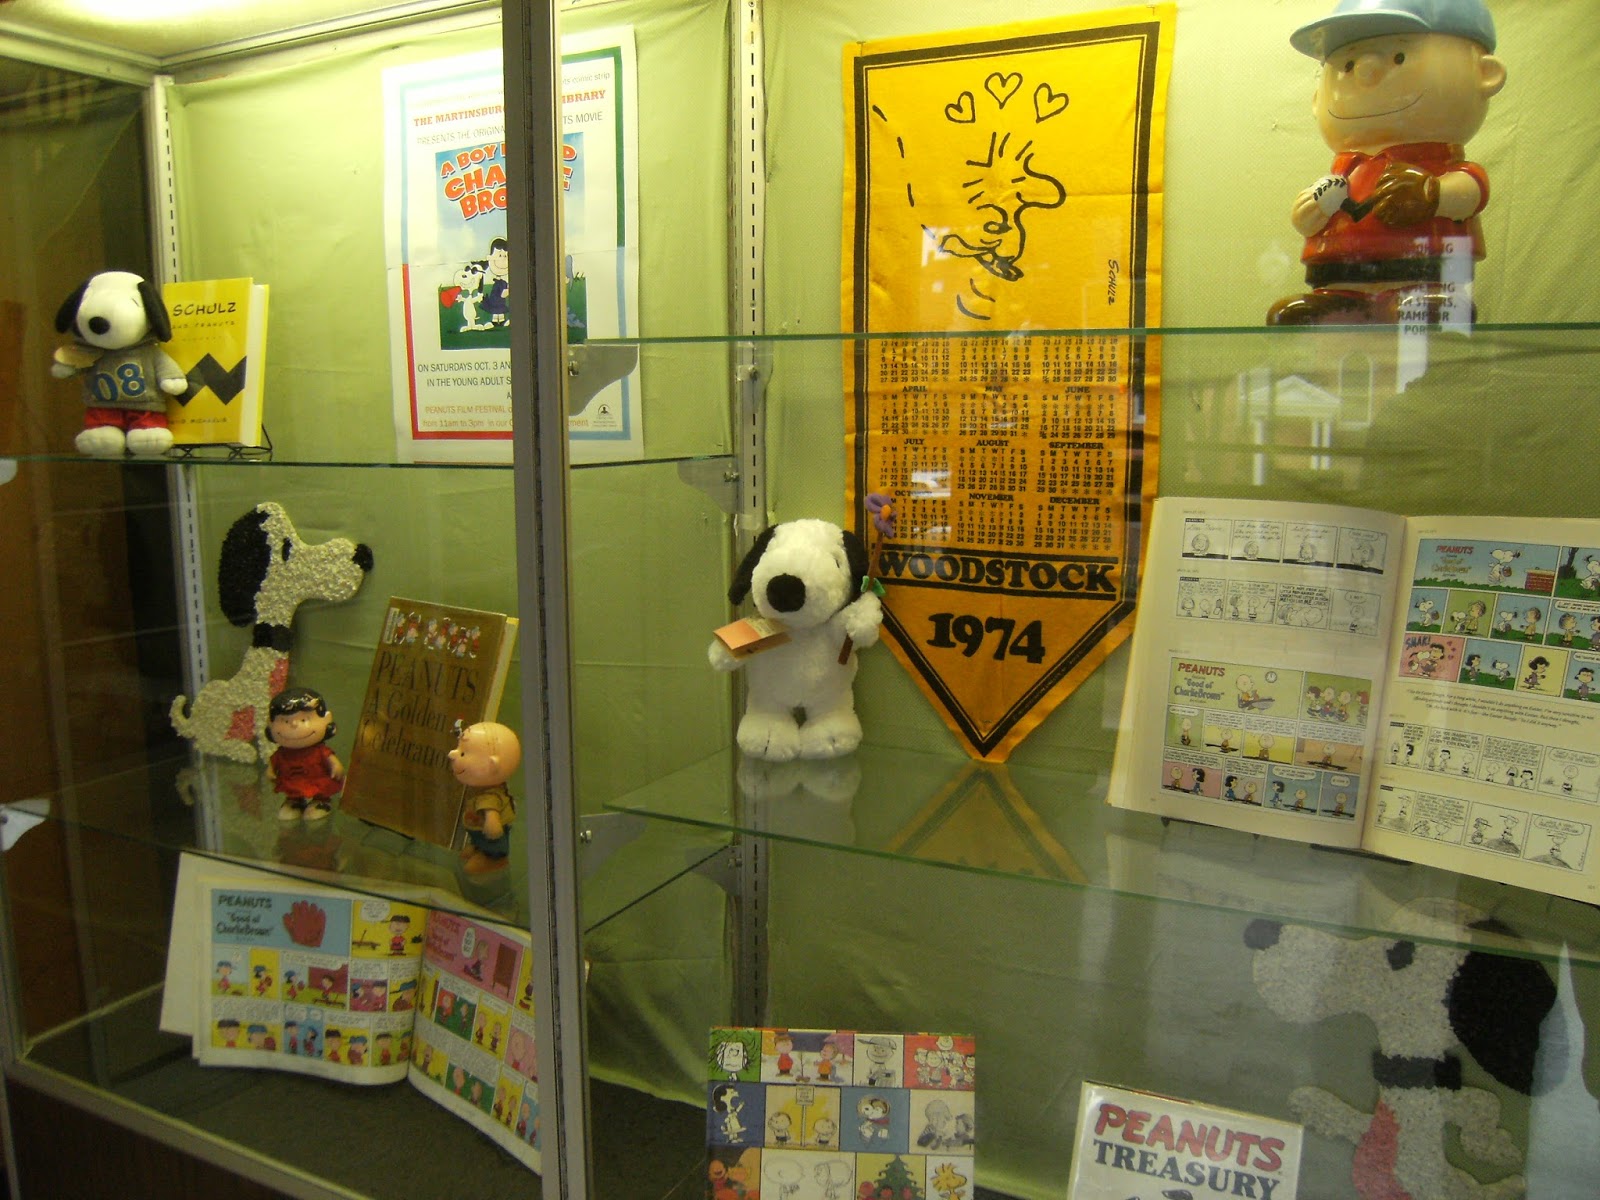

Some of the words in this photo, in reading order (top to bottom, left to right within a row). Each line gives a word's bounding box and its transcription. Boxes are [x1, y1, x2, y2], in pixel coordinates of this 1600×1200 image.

[561, 89, 606, 104] IBRARY
[414, 116, 433, 127] THE
[435, 105, 505, 124] MARTINSBUR
[576, 111, 603, 124] MOVIE
[457, 130, 470, 140] THE
[473, 125, 505, 138] ORIGINA
[441, 161, 455, 178] A
[457, 143, 497, 170] BOY
[459, 187, 508, 220] BRO
[1108, 259, 1120, 306] SCHULZ
[173, 302, 237, 317] SCHULZ
[417, 363, 429, 373] ON
[430, 361, 473, 373] SATURDAYS
[474, 361, 492, 371] OCT.
[493, 361, 499, 370] 3
[501, 360, 512, 370] AN
[92, 361, 146, 402] 08
[427, 378, 435, 387] IN
[436, 378, 451, 387] THE
[452, 377, 479, 387] YOUNG
[480, 376, 504, 386] ADULT
[902, 385, 929, 394] APRIL
[1065, 386, 1091, 394] JUNE
[425, 406, 456, 415] PEANUTS
[457, 405, 473, 414] FILM
[475, 405, 506, 414] FESTIVAL
[439, 419, 459, 428] 11am
[460, 419, 467, 427] to
[468, 419, 485, 429] 3pm
[975, 439, 1010, 447] AUGUST
[1048, 441, 1105, 450] SEPTEMBER
[968, 492, 1014, 502] NOVEMBER
[1049, 496, 1101, 505] DECEMBER
[1436, 545, 1474, 555] PEANUTS
[877, 550, 1118, 593] WOODSTOCK
[926, 612, 1046, 665] 1974
[375, 650, 479, 704] PEANUTS
[1178, 662, 1226, 678] PEANUTS
[386, 689, 448, 733] Golden
[217, 894, 273, 910] PEANUTS
[1094, 1103, 1286, 1172] PEANUTS
[1093, 1139, 1280, 1200] TREASURY
